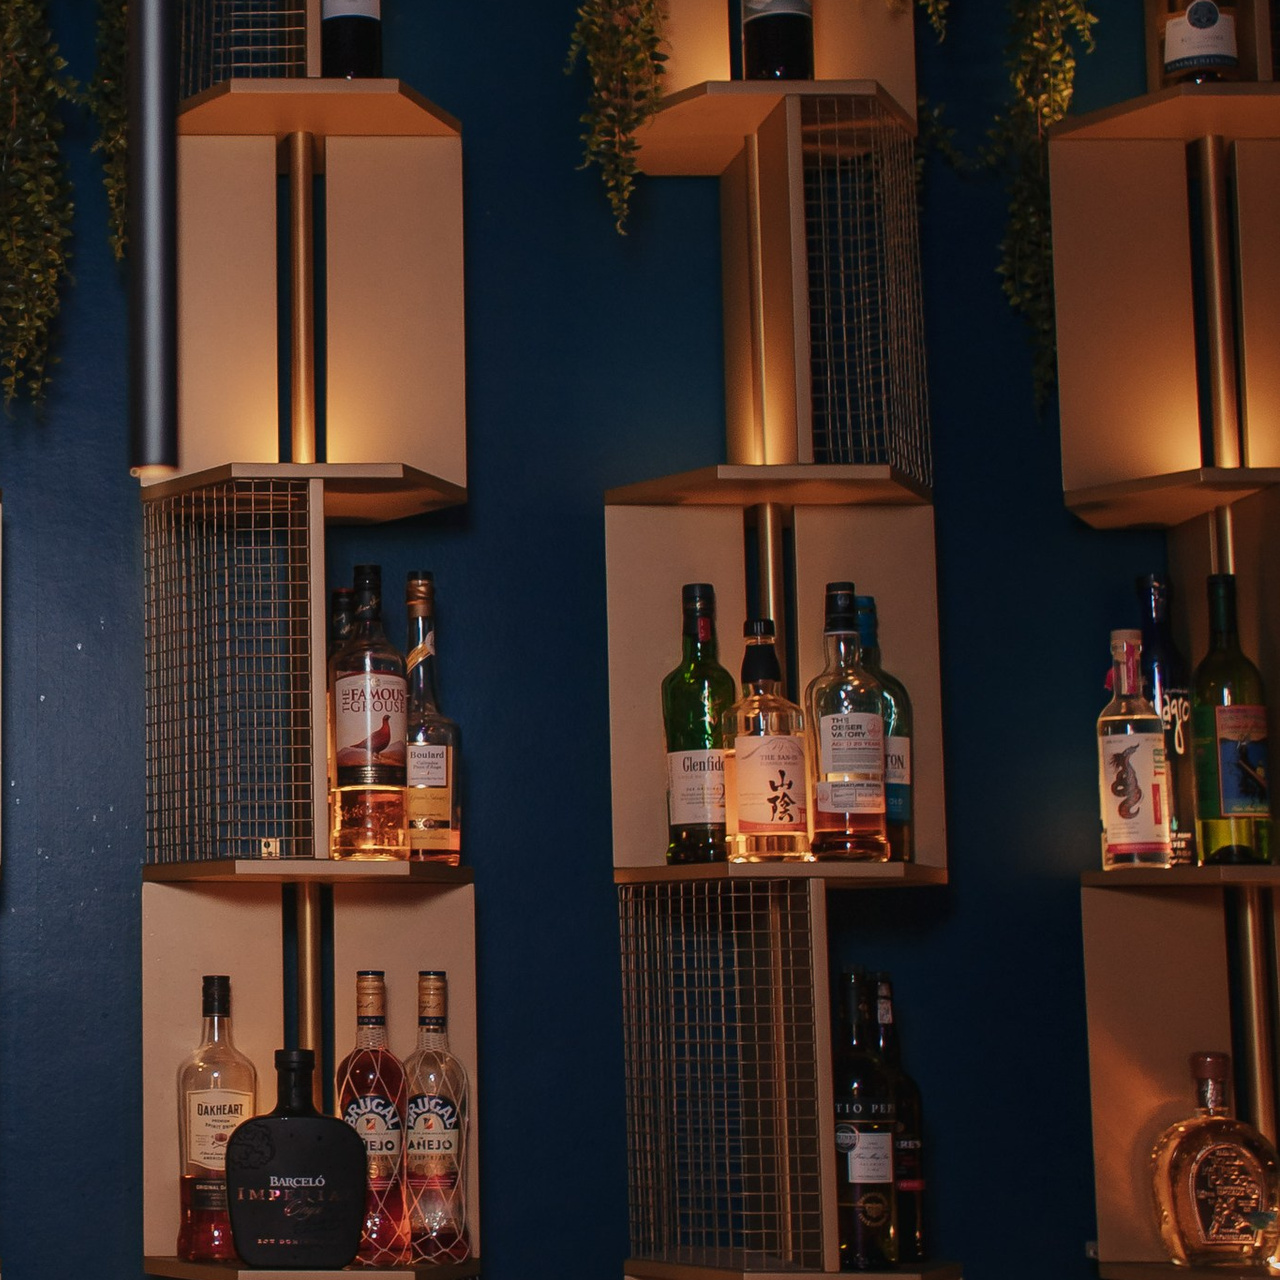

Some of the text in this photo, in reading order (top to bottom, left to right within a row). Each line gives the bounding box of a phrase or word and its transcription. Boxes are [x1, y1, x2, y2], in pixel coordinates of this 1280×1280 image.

[352, 688, 405, 701] FAMOUS
[410, 751, 444, 759] Boulard
[197, 1103, 243, 1117] OAKHEART
[344, 1097, 399, 1129] BRUGAL
[408, 1097, 457, 1129] BRUGAL
[835, 1103, 862, 1113] TIO
[408, 1137, 453, 1151] AÑEJO
[270, 1175, 325, 1188] BARCELÓ
